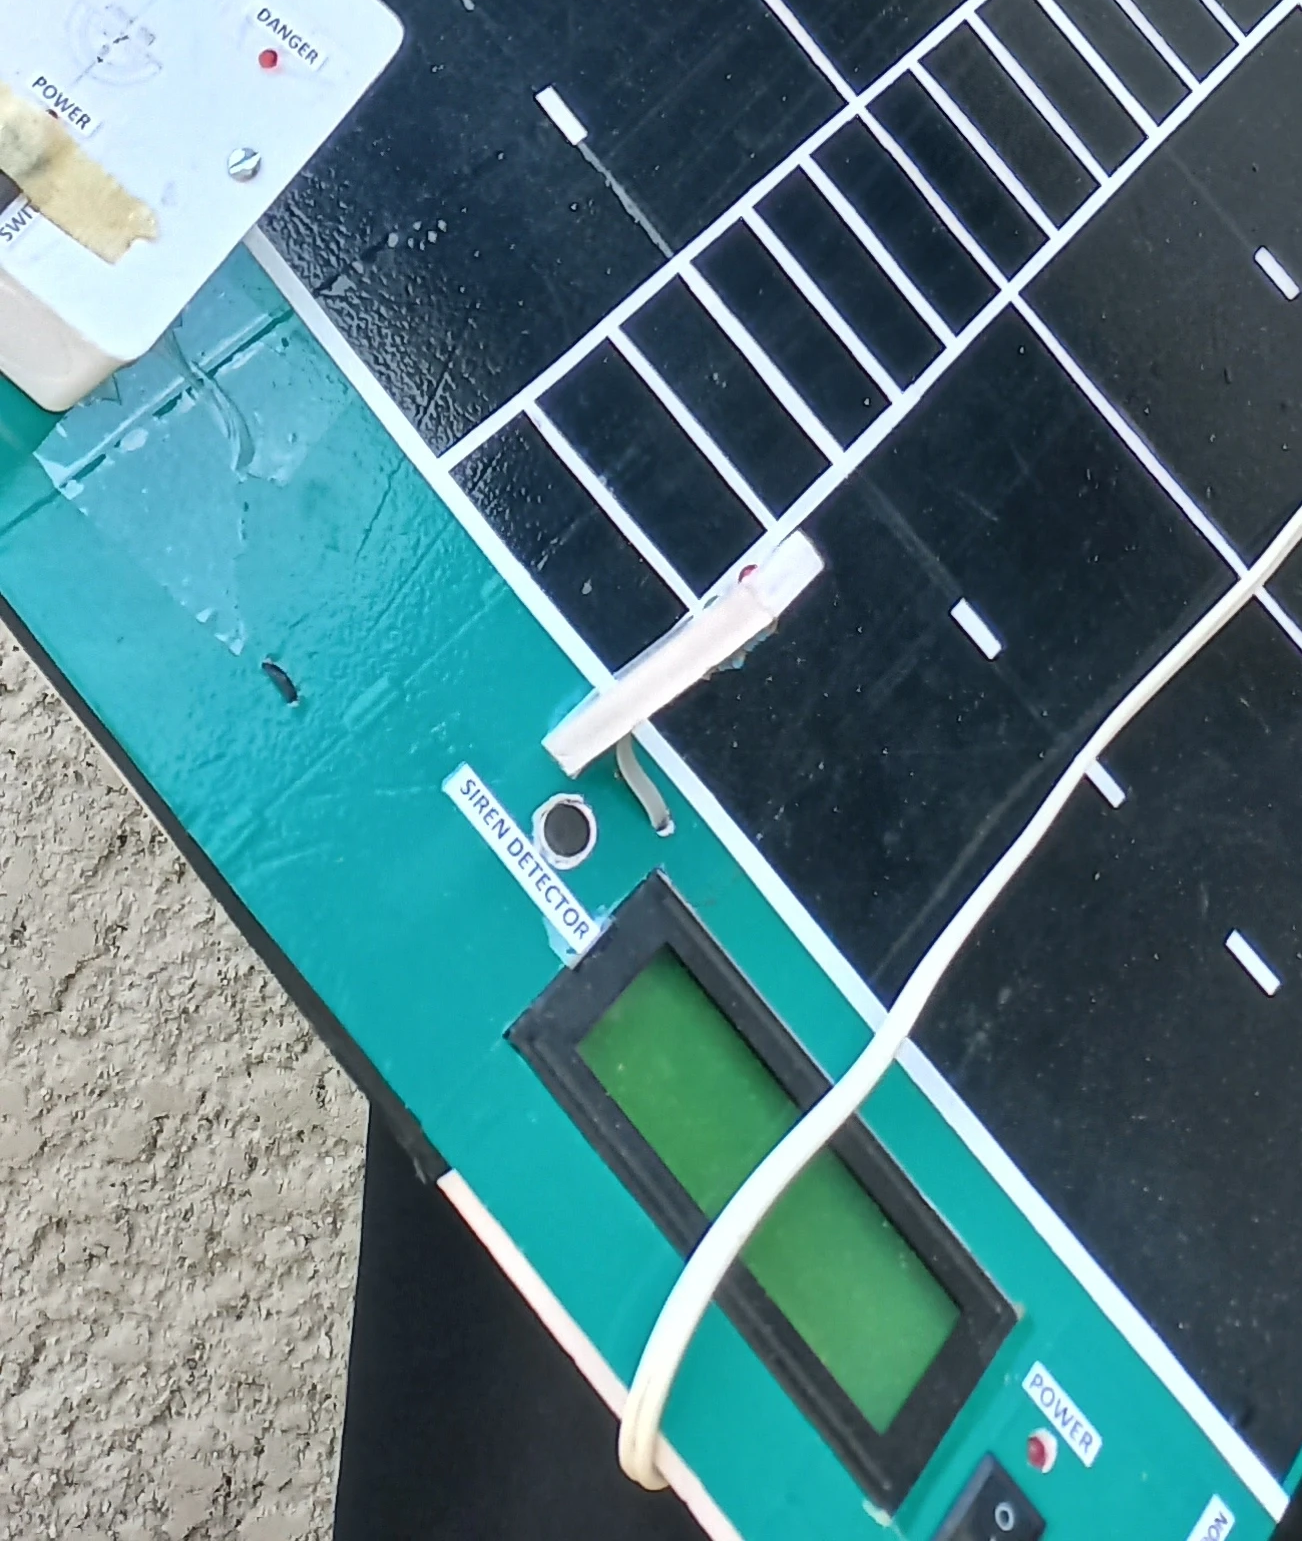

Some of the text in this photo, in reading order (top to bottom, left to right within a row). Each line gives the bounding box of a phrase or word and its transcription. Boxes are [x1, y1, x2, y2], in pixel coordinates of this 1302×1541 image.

[256, 7, 319, 65] DANGER
[31, 75, 92, 130] POWER
[459, 778, 590, 940] SIREN DETECTOR
[1028, 1373, 1094, 1455] POWER
